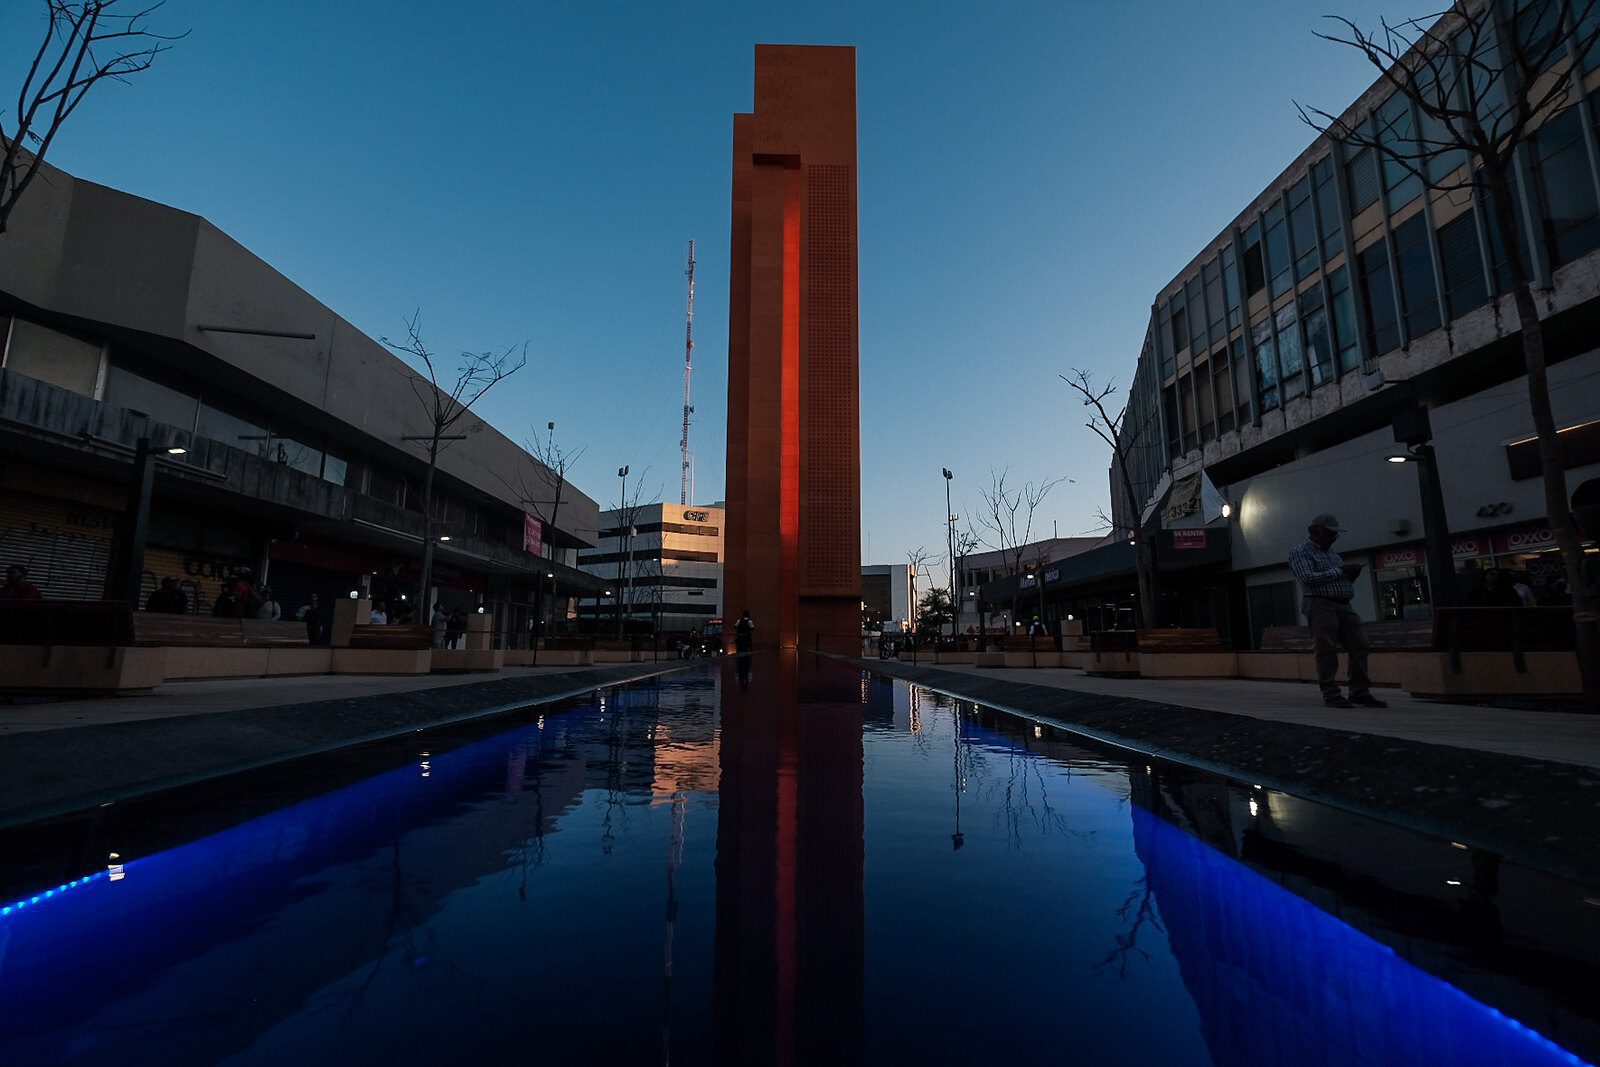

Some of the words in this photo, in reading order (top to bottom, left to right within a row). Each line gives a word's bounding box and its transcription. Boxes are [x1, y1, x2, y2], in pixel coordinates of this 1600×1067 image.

[1476, 502, 1512, 517] 420
[1510, 528, 1552, 546] OXXO
[1451, 540, 1476, 554] XXO
[1384, 550, 1414, 564] OXXO
